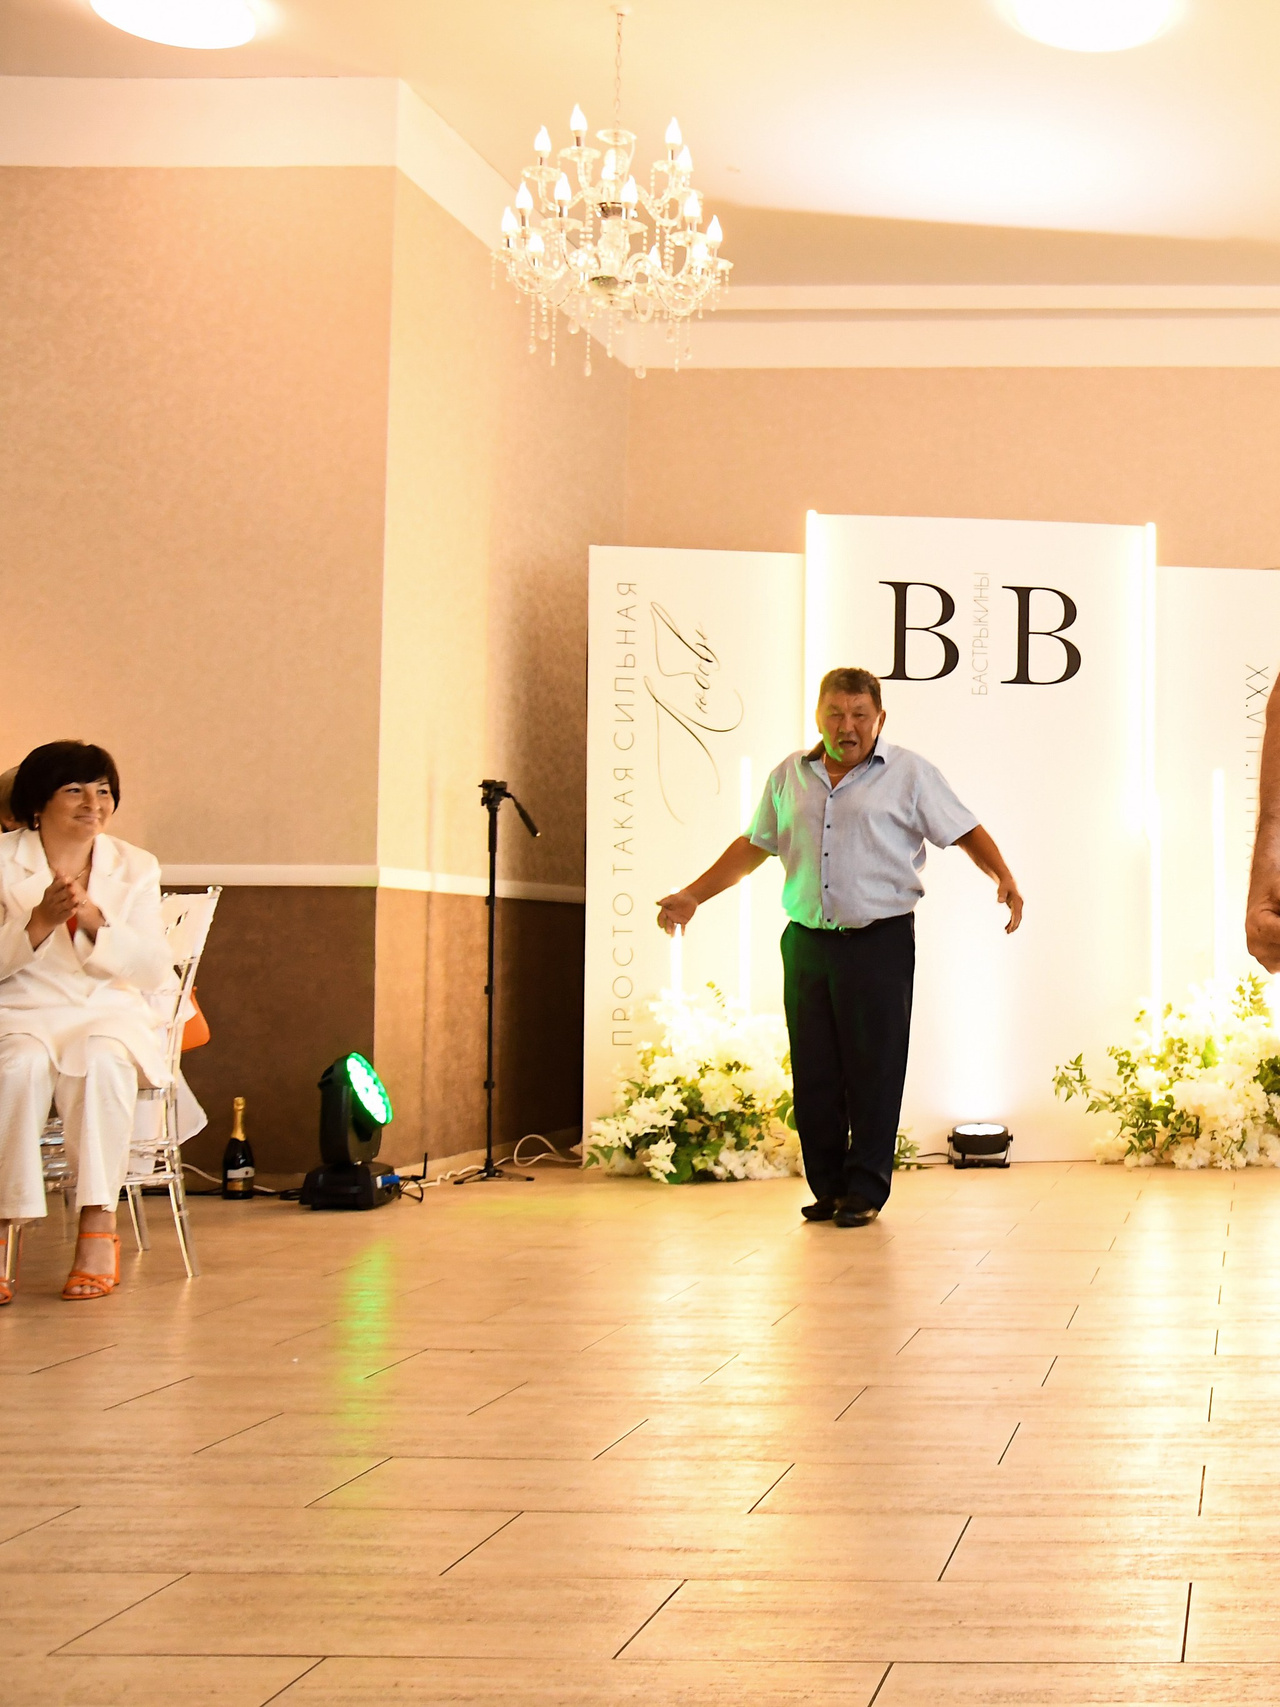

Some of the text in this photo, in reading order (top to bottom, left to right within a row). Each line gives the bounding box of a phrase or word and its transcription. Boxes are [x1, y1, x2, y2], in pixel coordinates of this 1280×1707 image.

[971, 572, 990, 696] БАСТРЫКИНЫ
[611, 582, 638, 1047] ПРОСТО ТАКАЯ СИЛЬНАЯ
